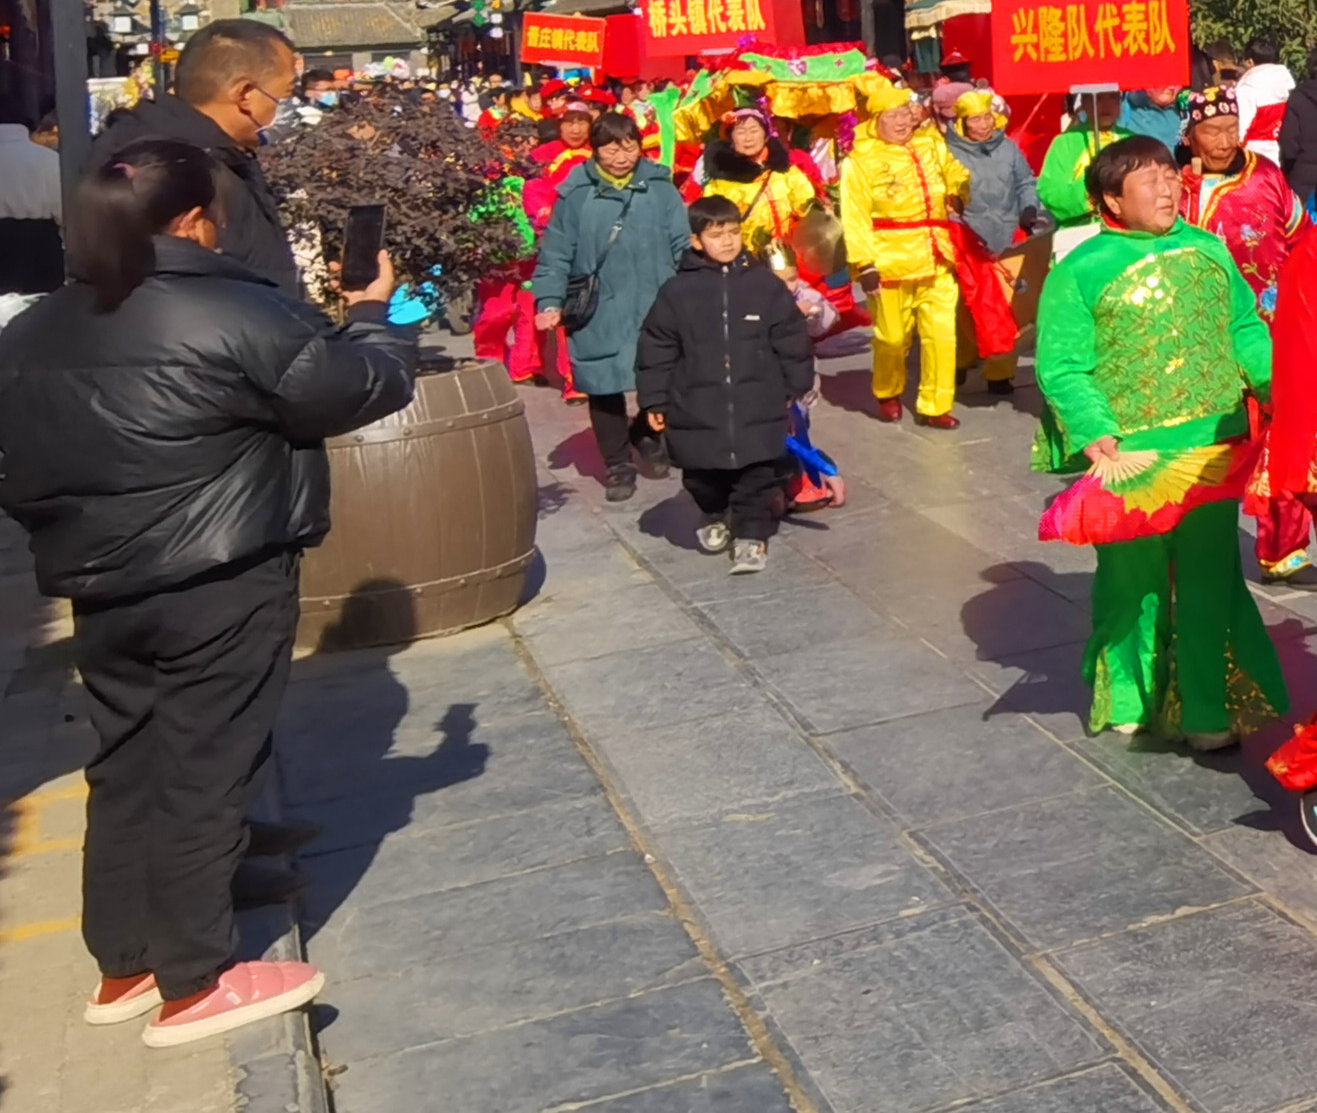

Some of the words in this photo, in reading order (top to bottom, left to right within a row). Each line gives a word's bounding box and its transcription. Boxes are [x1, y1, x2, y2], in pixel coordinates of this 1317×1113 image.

[1010, 0, 1176, 62] 兴隆队代表队
